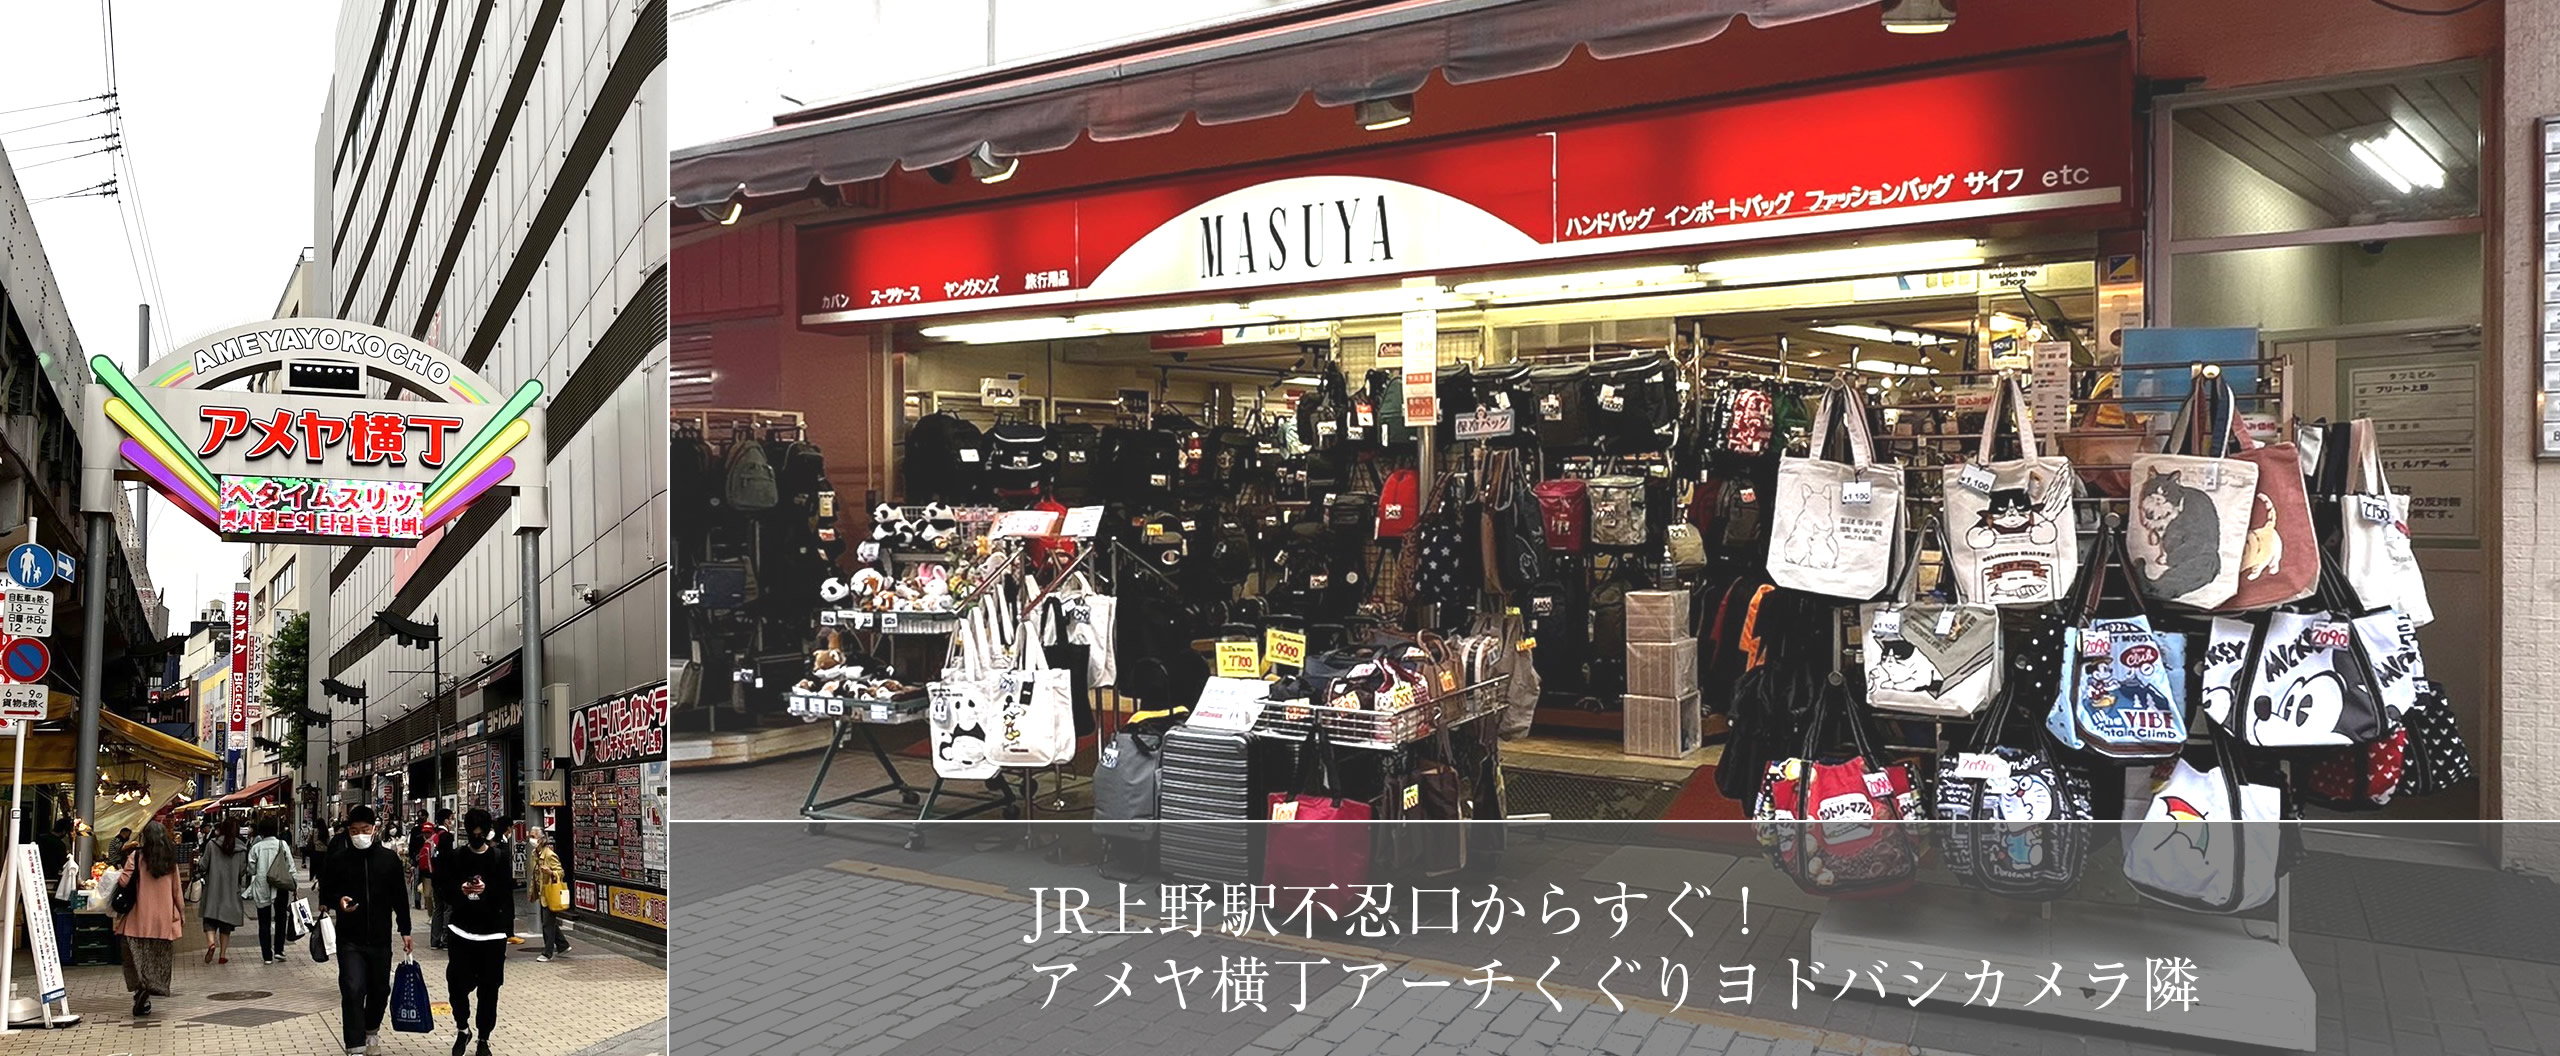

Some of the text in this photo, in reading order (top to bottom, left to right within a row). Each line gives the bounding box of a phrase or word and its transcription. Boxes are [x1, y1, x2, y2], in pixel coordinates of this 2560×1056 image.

[1566, 163, 2090, 237] ハンドバッグ インポートバッグ ファッションバッグ サイフ etc
[1200, 195, 1394, 279] MASUYA
[822, 269, 1070, 309] カバン スーツケース ヤングメンズ 旅行用品
[1989, 269, 2037, 279] inside the
[193, 327, 451, 386] AMEYAYOKOCHO
[987, 388, 1014, 398] FILA
[199, 405, 463, 467] アメヤ横丁
[228, 481, 423, 512] ヘタイムスリッ
[8, 593, 49, 604] 自転車を除く
[10, 603, 22, 613] 13
[9, 623, 21, 633] 12
[234, 600, 247, 655] カラオケ
[2312, 629, 2347, 646] 2090
[487, 700, 524, 734] ヨドバシカメ
[588, 685, 667, 742] ヨドバシカメラ
[490, 743, 502, 809] ヨドバシカメラ
